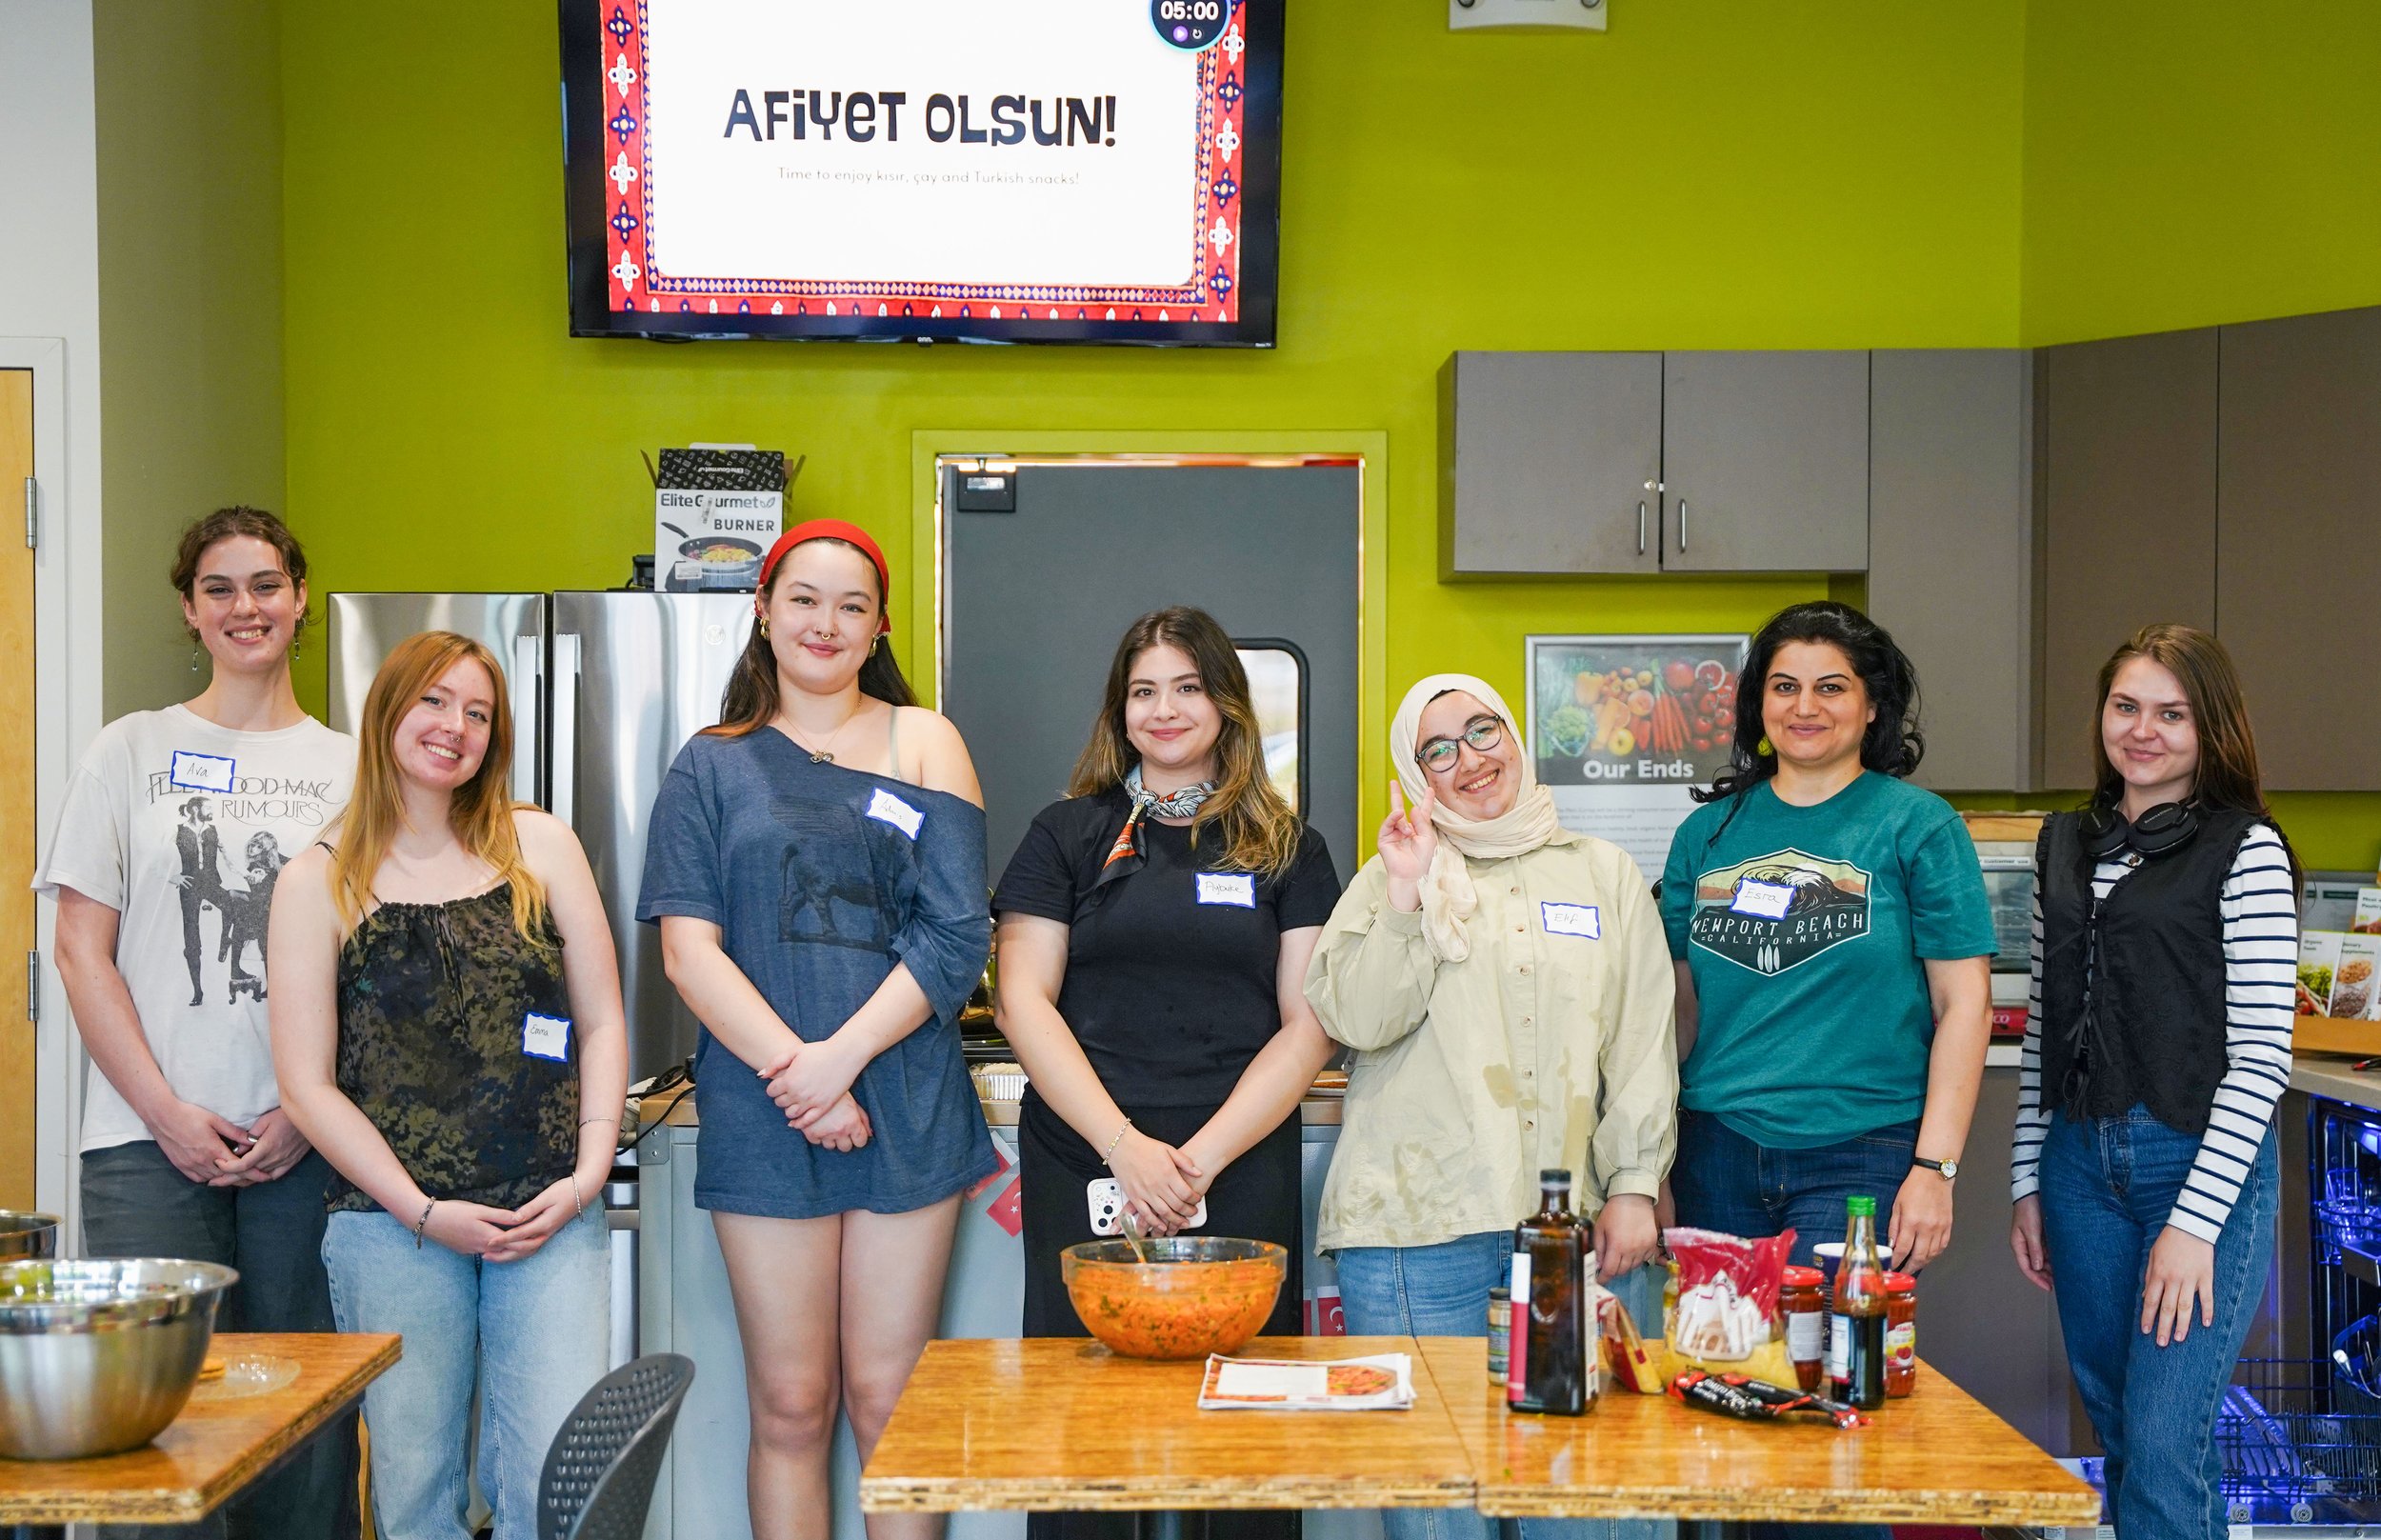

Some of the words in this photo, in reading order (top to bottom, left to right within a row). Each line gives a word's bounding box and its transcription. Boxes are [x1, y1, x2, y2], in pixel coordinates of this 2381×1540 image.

[1160, 0, 1219, 20] 05:00
[778, 167, 812, 180] Time
[816, 169, 830, 180] to
[834, 170, 872, 184] enjoy
[914, 173, 937, 186] çay
[942, 171, 970, 183] and
[974, 170, 1024, 184] Turkish
[1029, 172, 1080, 185] snacks!
[713, 518, 775, 532] BURNER
[186, 762, 210, 777] Ava
[1583, 760, 1631, 779] Our
[1638, 759, 1694, 778] Ends
[285, 777, 345, 805] MAC
[221, 799, 324, 826] RUMOURS
[1745, 888, 1782, 904] Esra
[1691, 917, 1778, 936] NEWPORT
[1795, 912, 1863, 935] BEACH
[1707, 931, 1834, 946] CALIFORNIA
